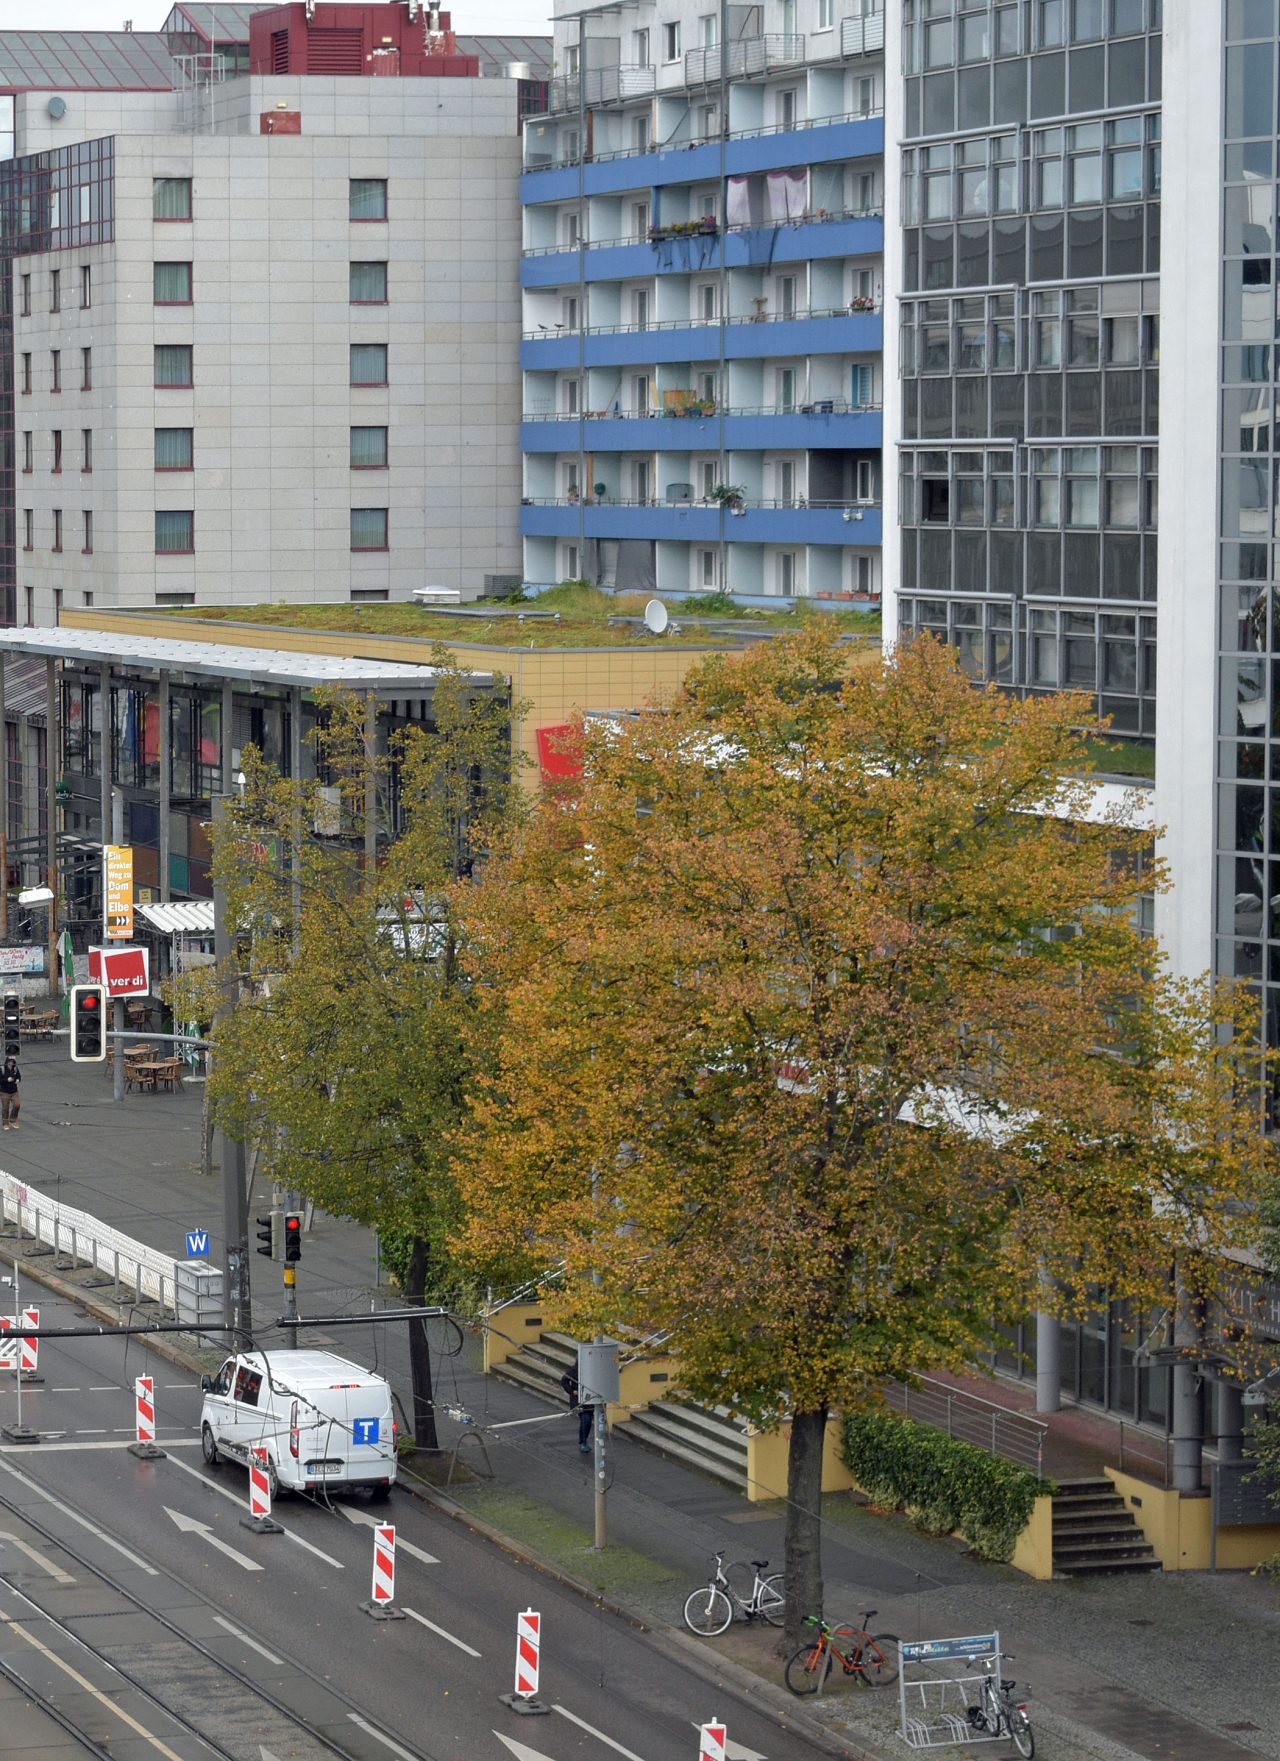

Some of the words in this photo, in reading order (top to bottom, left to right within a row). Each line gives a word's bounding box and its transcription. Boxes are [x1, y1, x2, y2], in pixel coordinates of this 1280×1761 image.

[108, 871, 123, 879] Weg
[109, 881, 129, 890] Dom
[109, 901, 130, 912] Elbe
[188, 1234, 207, 1252] W
[359, 1421, 373, 1441] T
